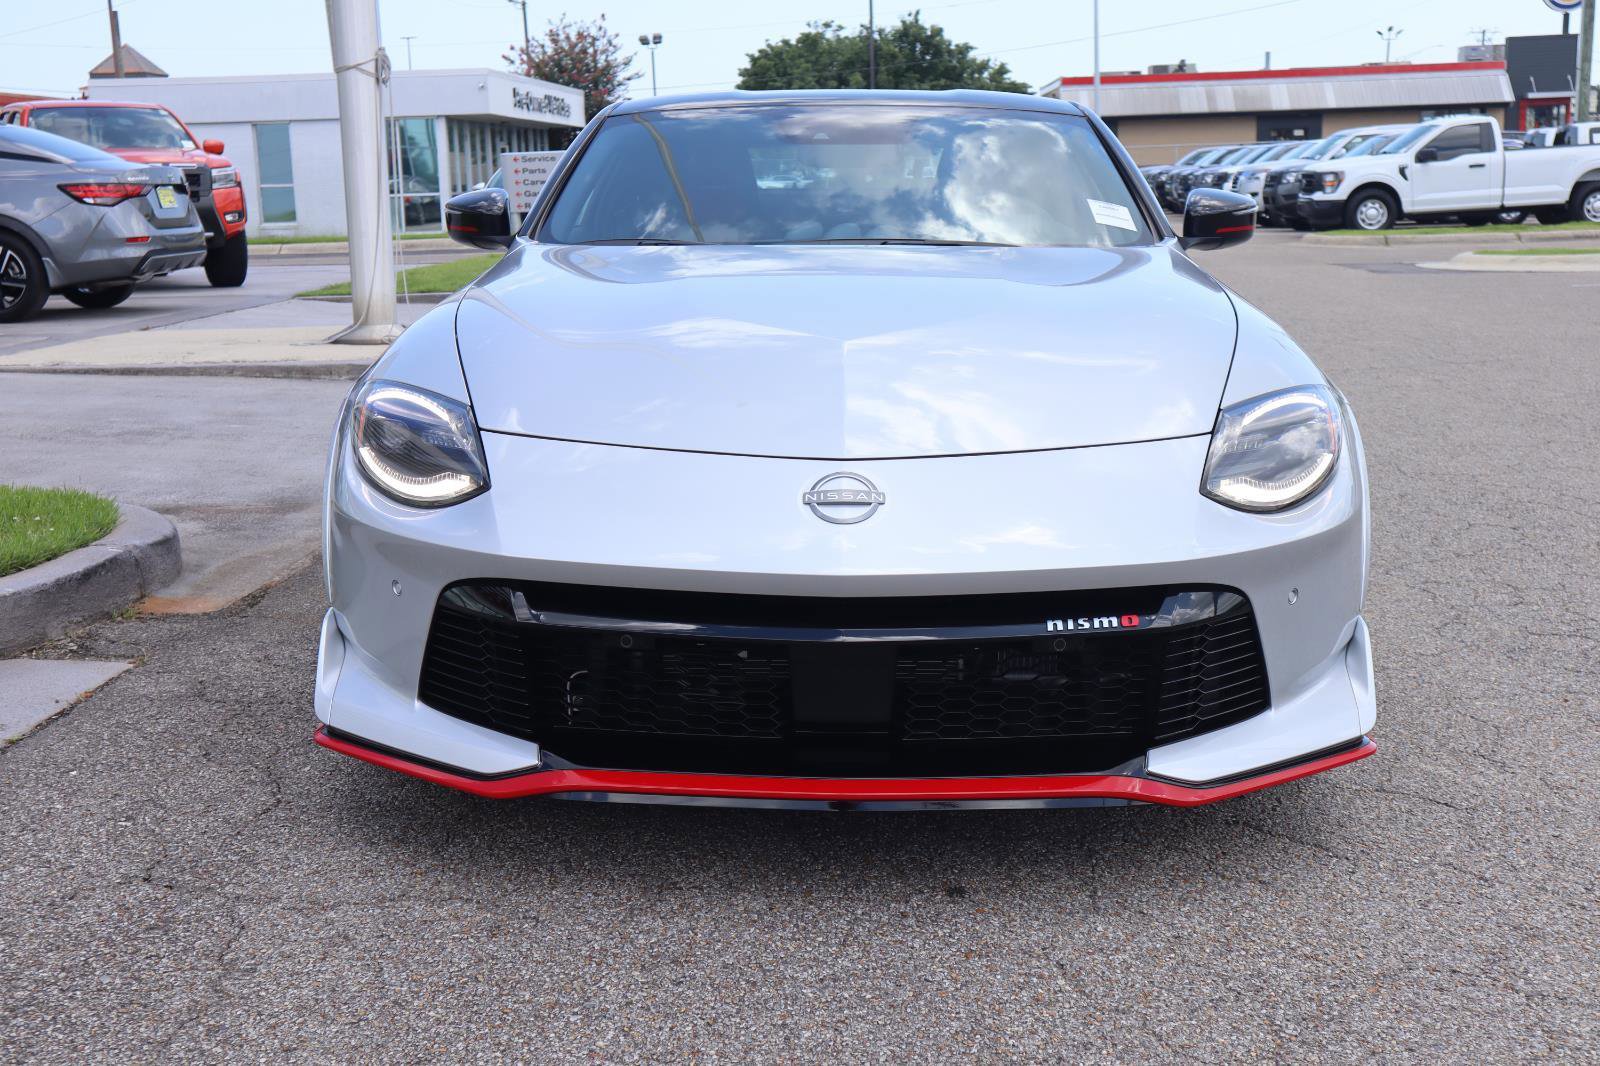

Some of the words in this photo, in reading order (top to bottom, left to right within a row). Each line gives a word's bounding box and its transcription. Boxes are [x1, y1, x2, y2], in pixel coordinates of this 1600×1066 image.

[521, 155, 556, 163] Service
[805, 492, 883, 502] NISSAN
[1046, 615, 1140, 632] nismo
